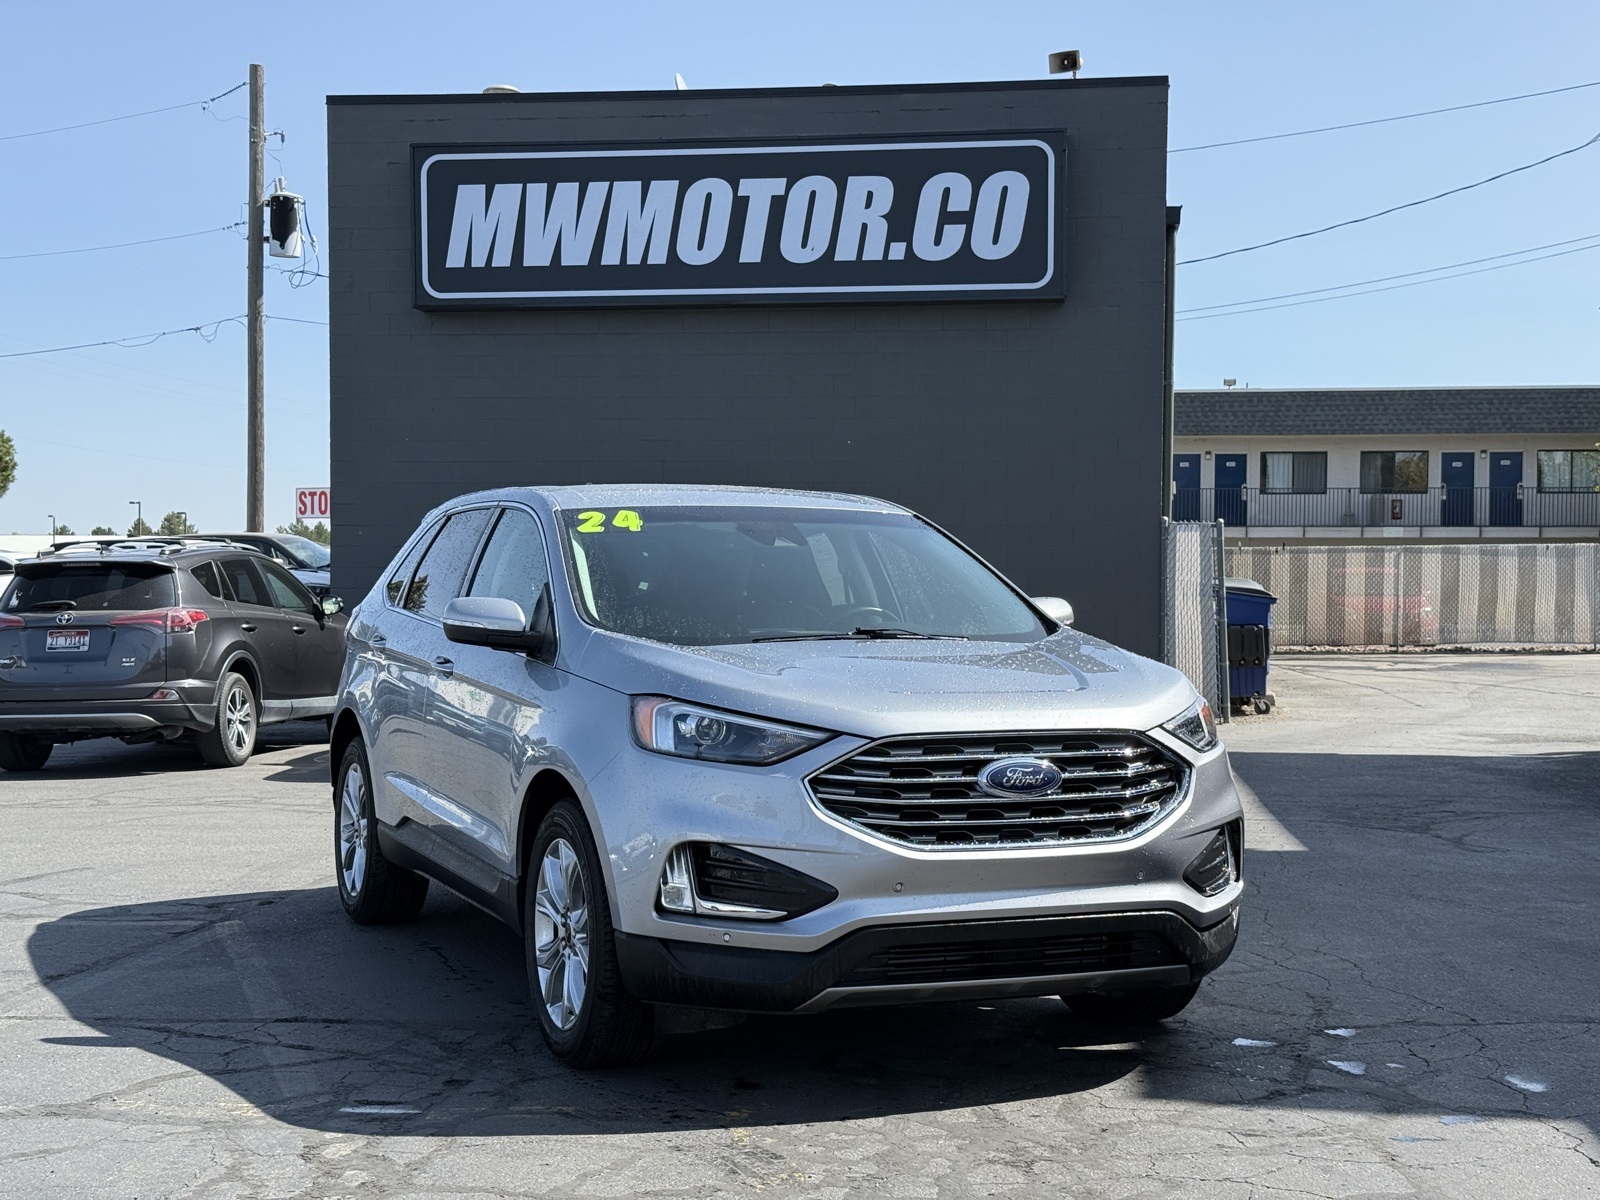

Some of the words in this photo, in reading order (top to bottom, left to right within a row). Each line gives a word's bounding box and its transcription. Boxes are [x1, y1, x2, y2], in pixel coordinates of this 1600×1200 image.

[445, 170, 1030, 268] MWMOTOR.CO
[577, 510, 643, 533] 24
[1003, 767, 1044, 787] Ford
